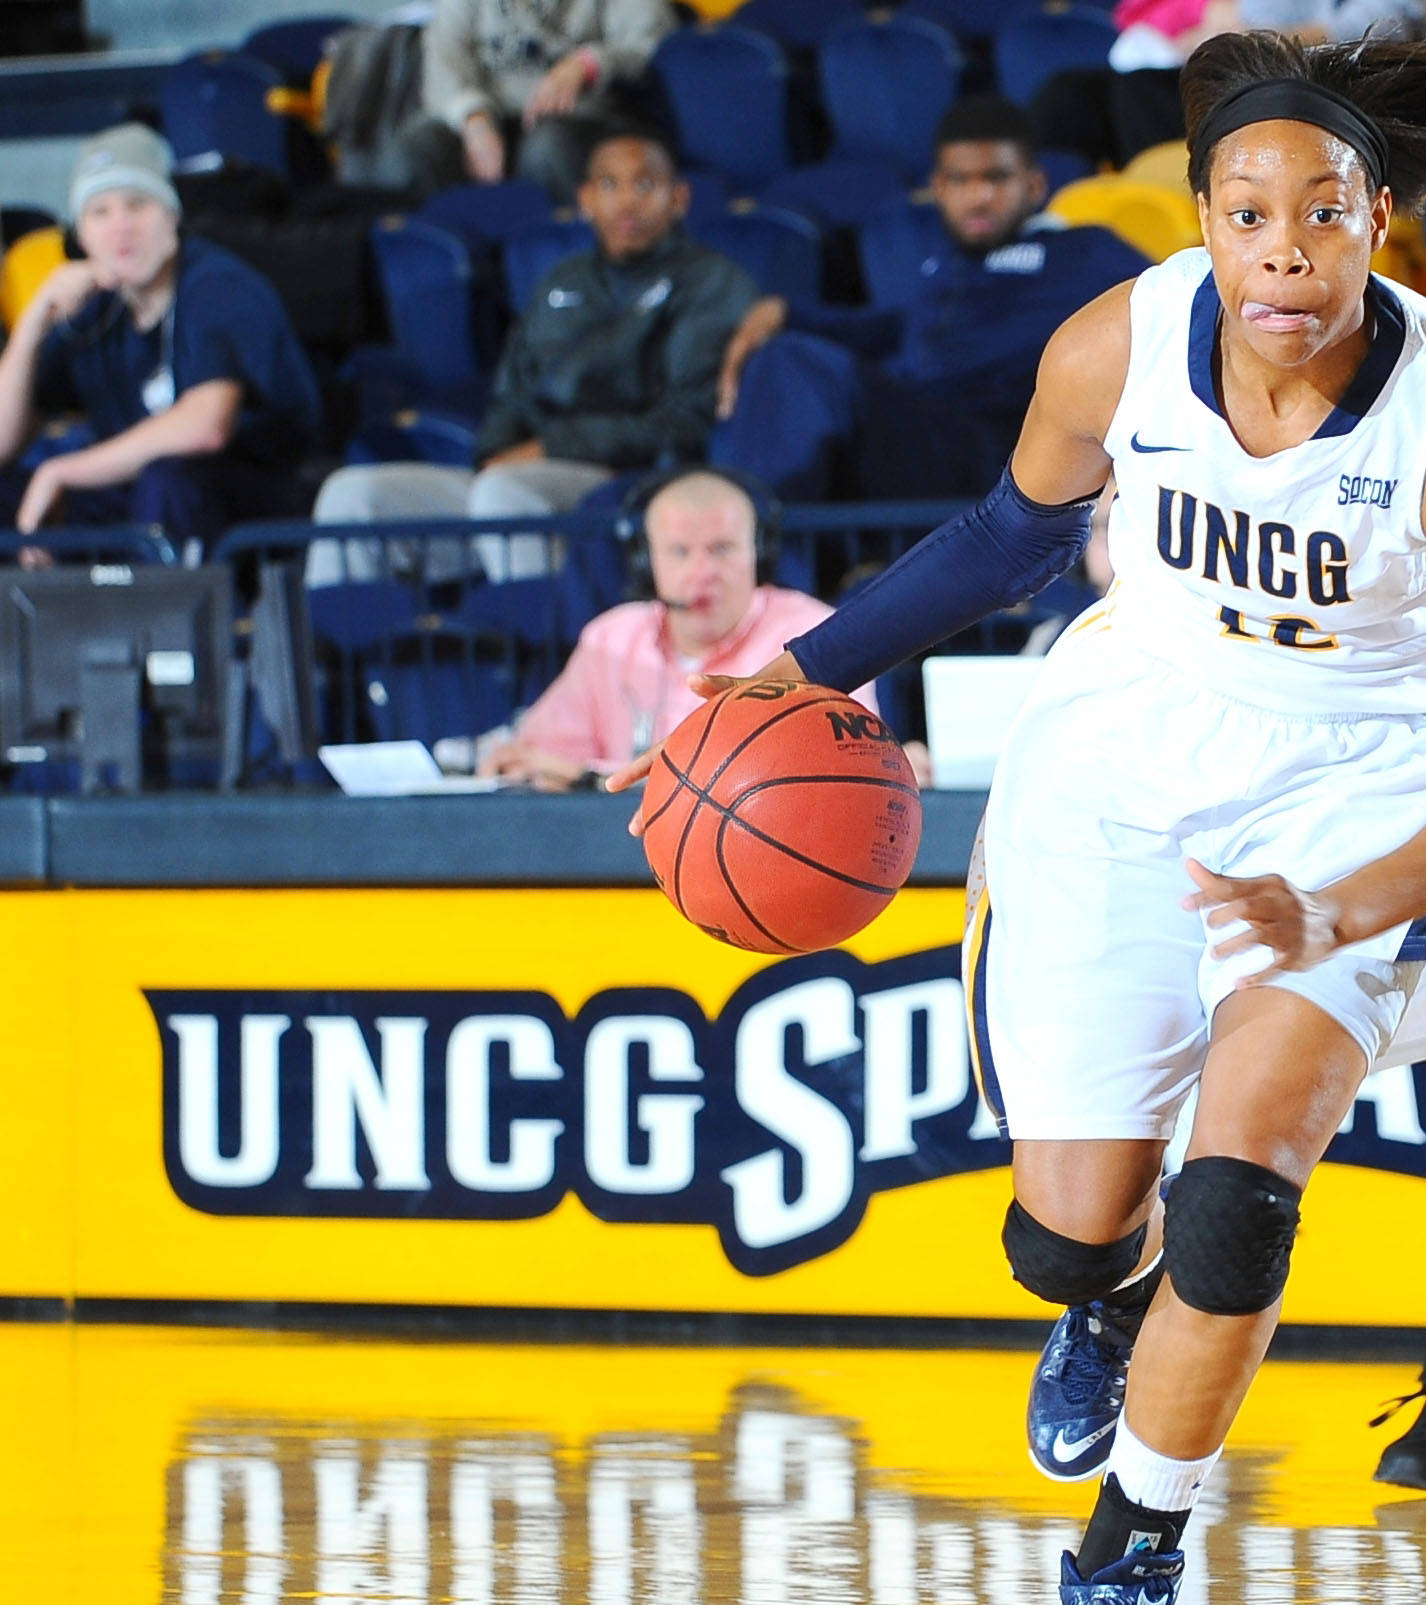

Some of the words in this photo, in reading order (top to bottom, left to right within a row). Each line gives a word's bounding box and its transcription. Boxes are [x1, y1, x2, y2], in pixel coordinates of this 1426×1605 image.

[1337, 474, 1399, 509] SOCON
[1157, 484, 1354, 607] UNCG
[825, 711, 902, 750] NCA
